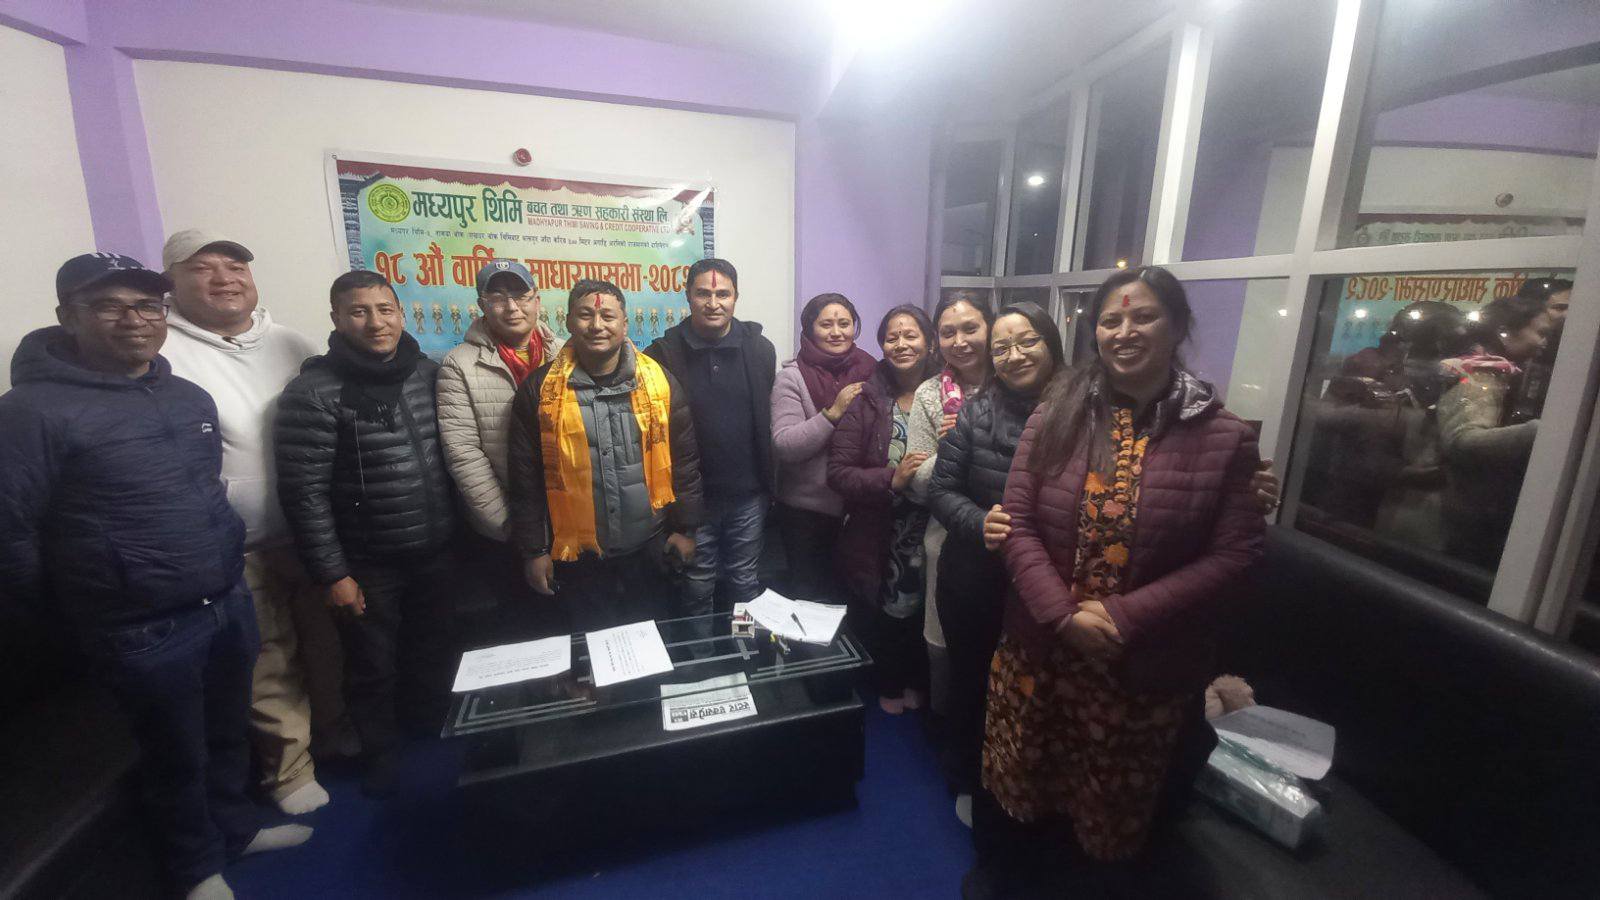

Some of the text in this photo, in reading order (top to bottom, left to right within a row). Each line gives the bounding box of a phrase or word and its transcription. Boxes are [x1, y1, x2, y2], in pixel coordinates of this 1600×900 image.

[411, 190, 477, 228] मध्यपुर
[481, 188, 523, 224] थिमि
[526, 201, 547, 215] बचत
[551, 203, 569, 216] तथा
[571, 204, 592, 218] ऋण
[595, 204, 629, 221] सहकारी
[632, 206, 654, 223] संस्था
[527, 217, 563, 227] MADHYAPUR
[579, 220, 599, 230] SAVING
[600, 222, 604, 230] &
[605, 222, 623, 231] CREDIT
[625, 223, 659, 233] COOPERATIVE
[375, 251, 406, 285] १८
